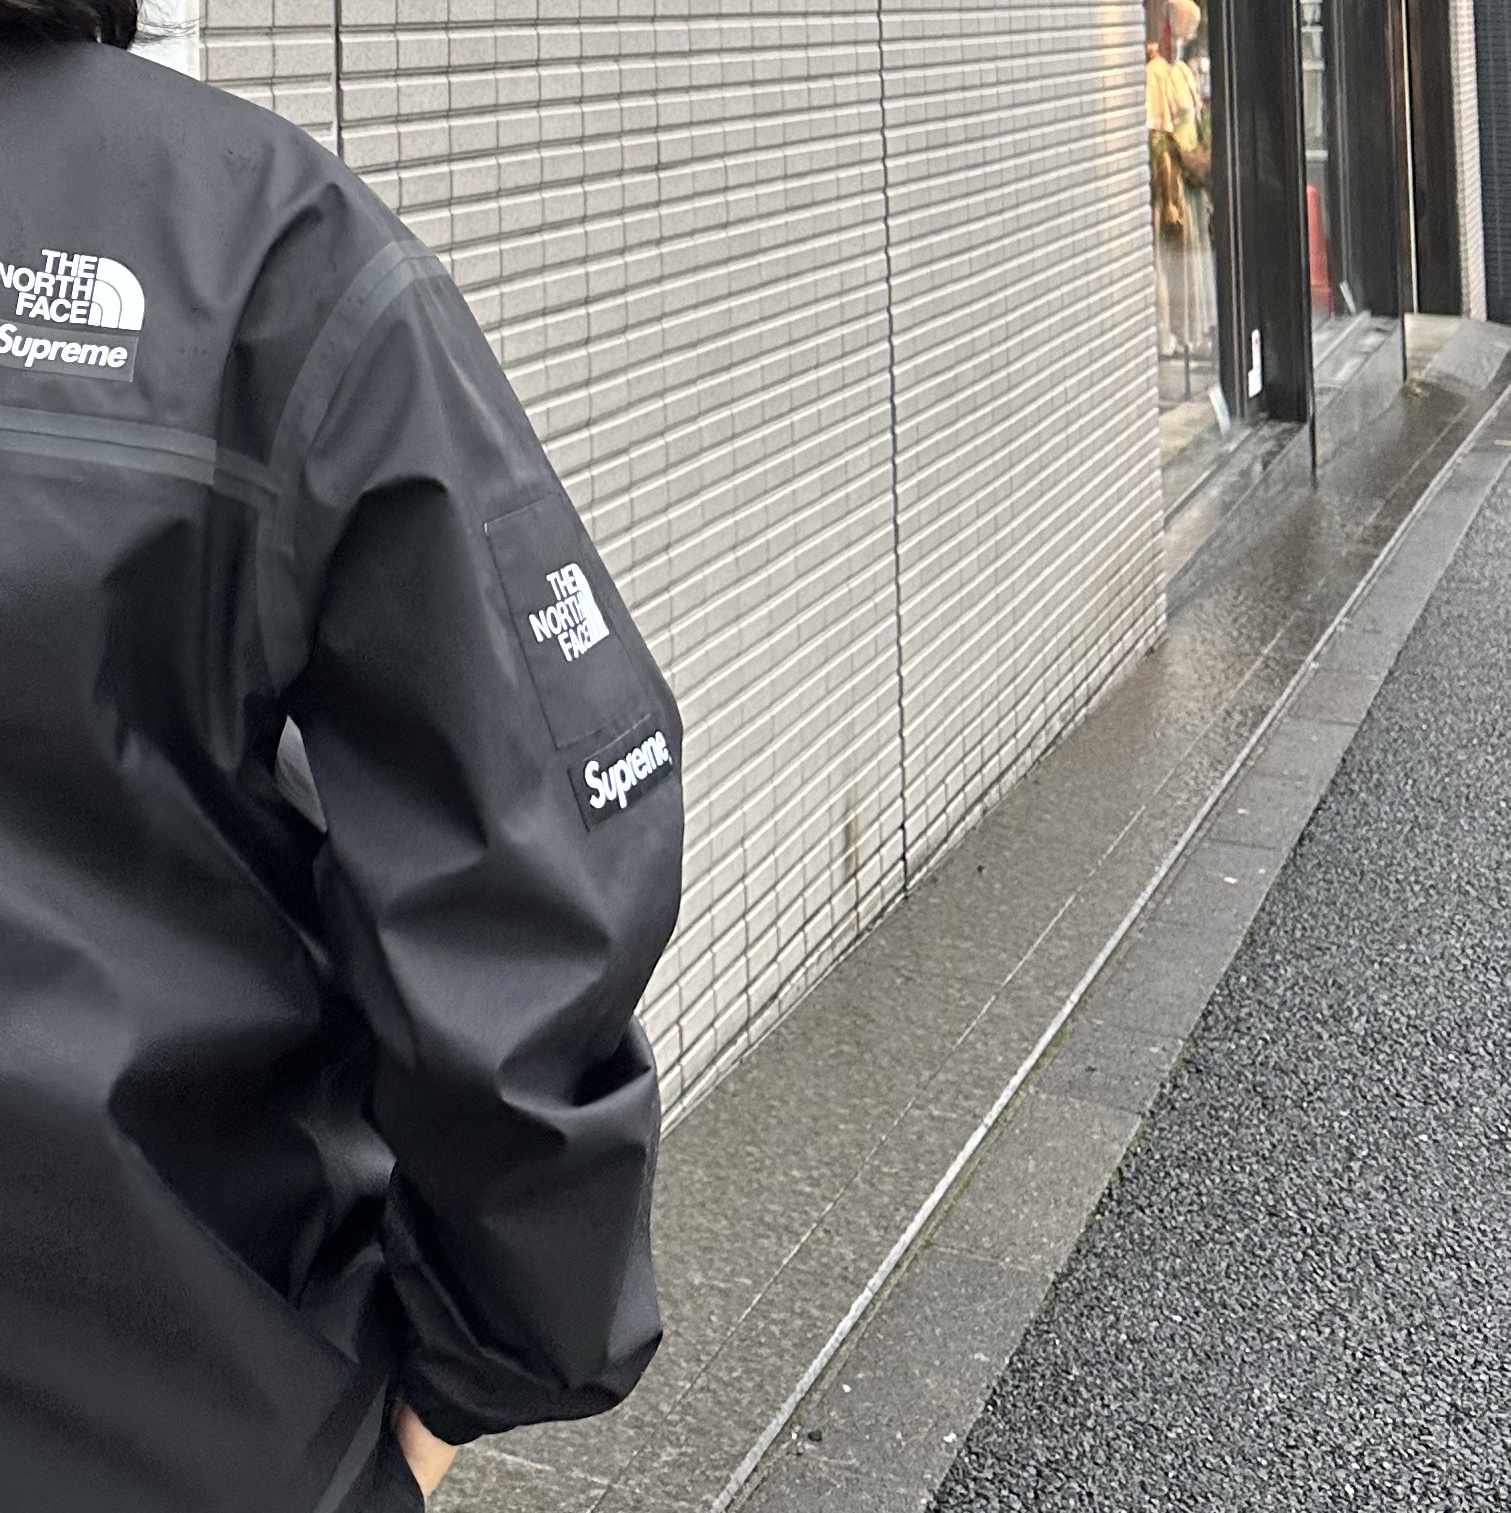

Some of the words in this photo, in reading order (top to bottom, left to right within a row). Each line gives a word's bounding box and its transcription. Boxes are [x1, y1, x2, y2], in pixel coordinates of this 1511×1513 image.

[41, 249, 98, 279] THE
[15, 292, 88, 324] FACE
[546, 564, 578, 601] THE
[528, 593, 587, 642] NORTH
[557, 622, 593, 661] FACE
[585, 731, 669, 809] Supreme
